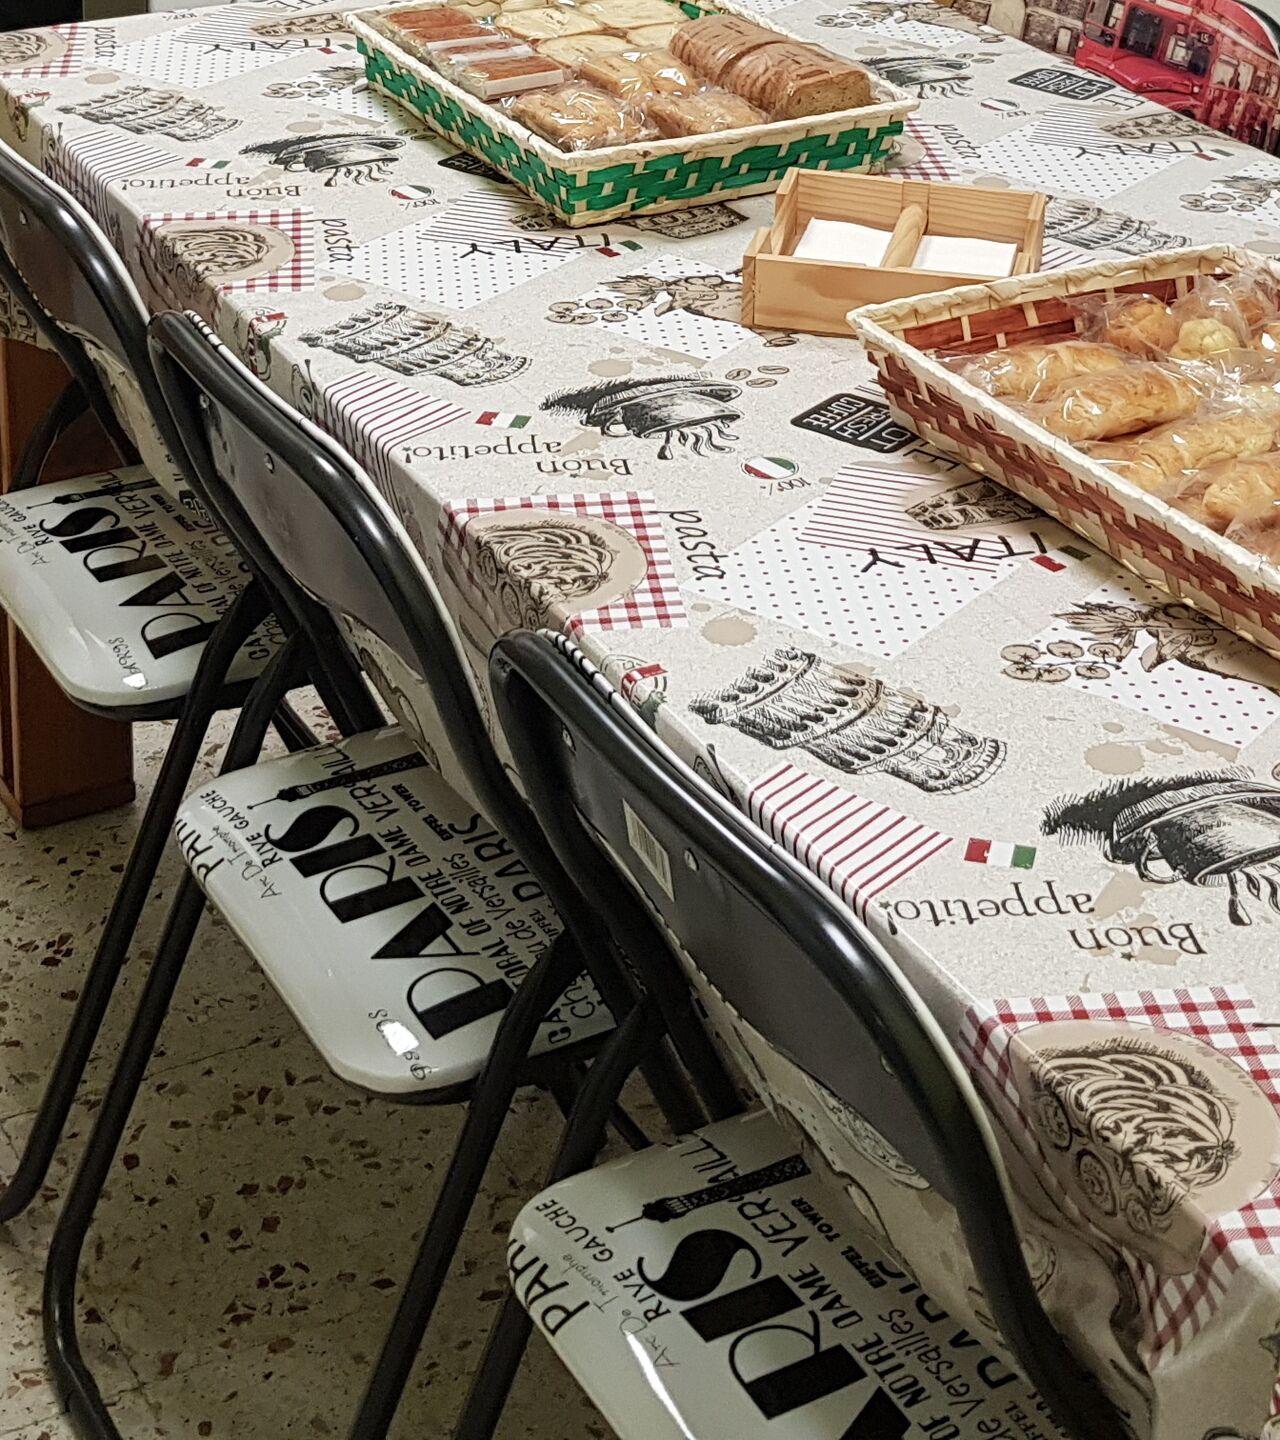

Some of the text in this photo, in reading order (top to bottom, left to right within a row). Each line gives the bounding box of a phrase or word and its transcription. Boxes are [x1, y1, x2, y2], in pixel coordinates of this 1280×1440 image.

[203, 37, 331, 55] ITALY
[929, 123, 982, 160] pasta
[1075, 141, 1204, 159] ITALY
[120, 172, 302, 198] Buon appetito!
[305, 216, 355, 263] pasta
[459, 232, 611, 260] ITALY
[802, 396, 866, 428] COFFEE
[405, 434, 634, 477] Buon appetito!
[872, 427, 911, 451] OT
[765, 476, 811, 497] 100%
[22, 523, 54, 548] RIVE
[133, 517, 173, 547] DAME
[650, 508, 728, 582] pasta
[860, 531, 1047, 573] ITALY
[39, 506, 224, 661] PARIS
[167, 546, 201, 581] NOTRE
[199, 788, 284, 872] RIVE GAUCHE
[391, 783, 454, 842] EIFFEL TOWER
[377, 824, 430, 873] DAME
[419, 869, 473, 916] NOTRE
[442, 850, 538, 951] de Versailles
[264, 803, 518, 1042] PARIS
[459, 905, 491, 939] OF
[886, 879, 1209, 956] Buon appetito!
[535, 1196, 672, 1324] RIVE GAUCHE
[790, 1196, 887, 1289] EIFFEL TOWER
[561, 1251, 619, 1313] Triomphe
[787, 1261, 865, 1331] DAME
[641, 1333, 680, 1369] Arc
[851, 1332, 932, 1408] NOTRE
[877, 1308, 985, 1419] Versailles
